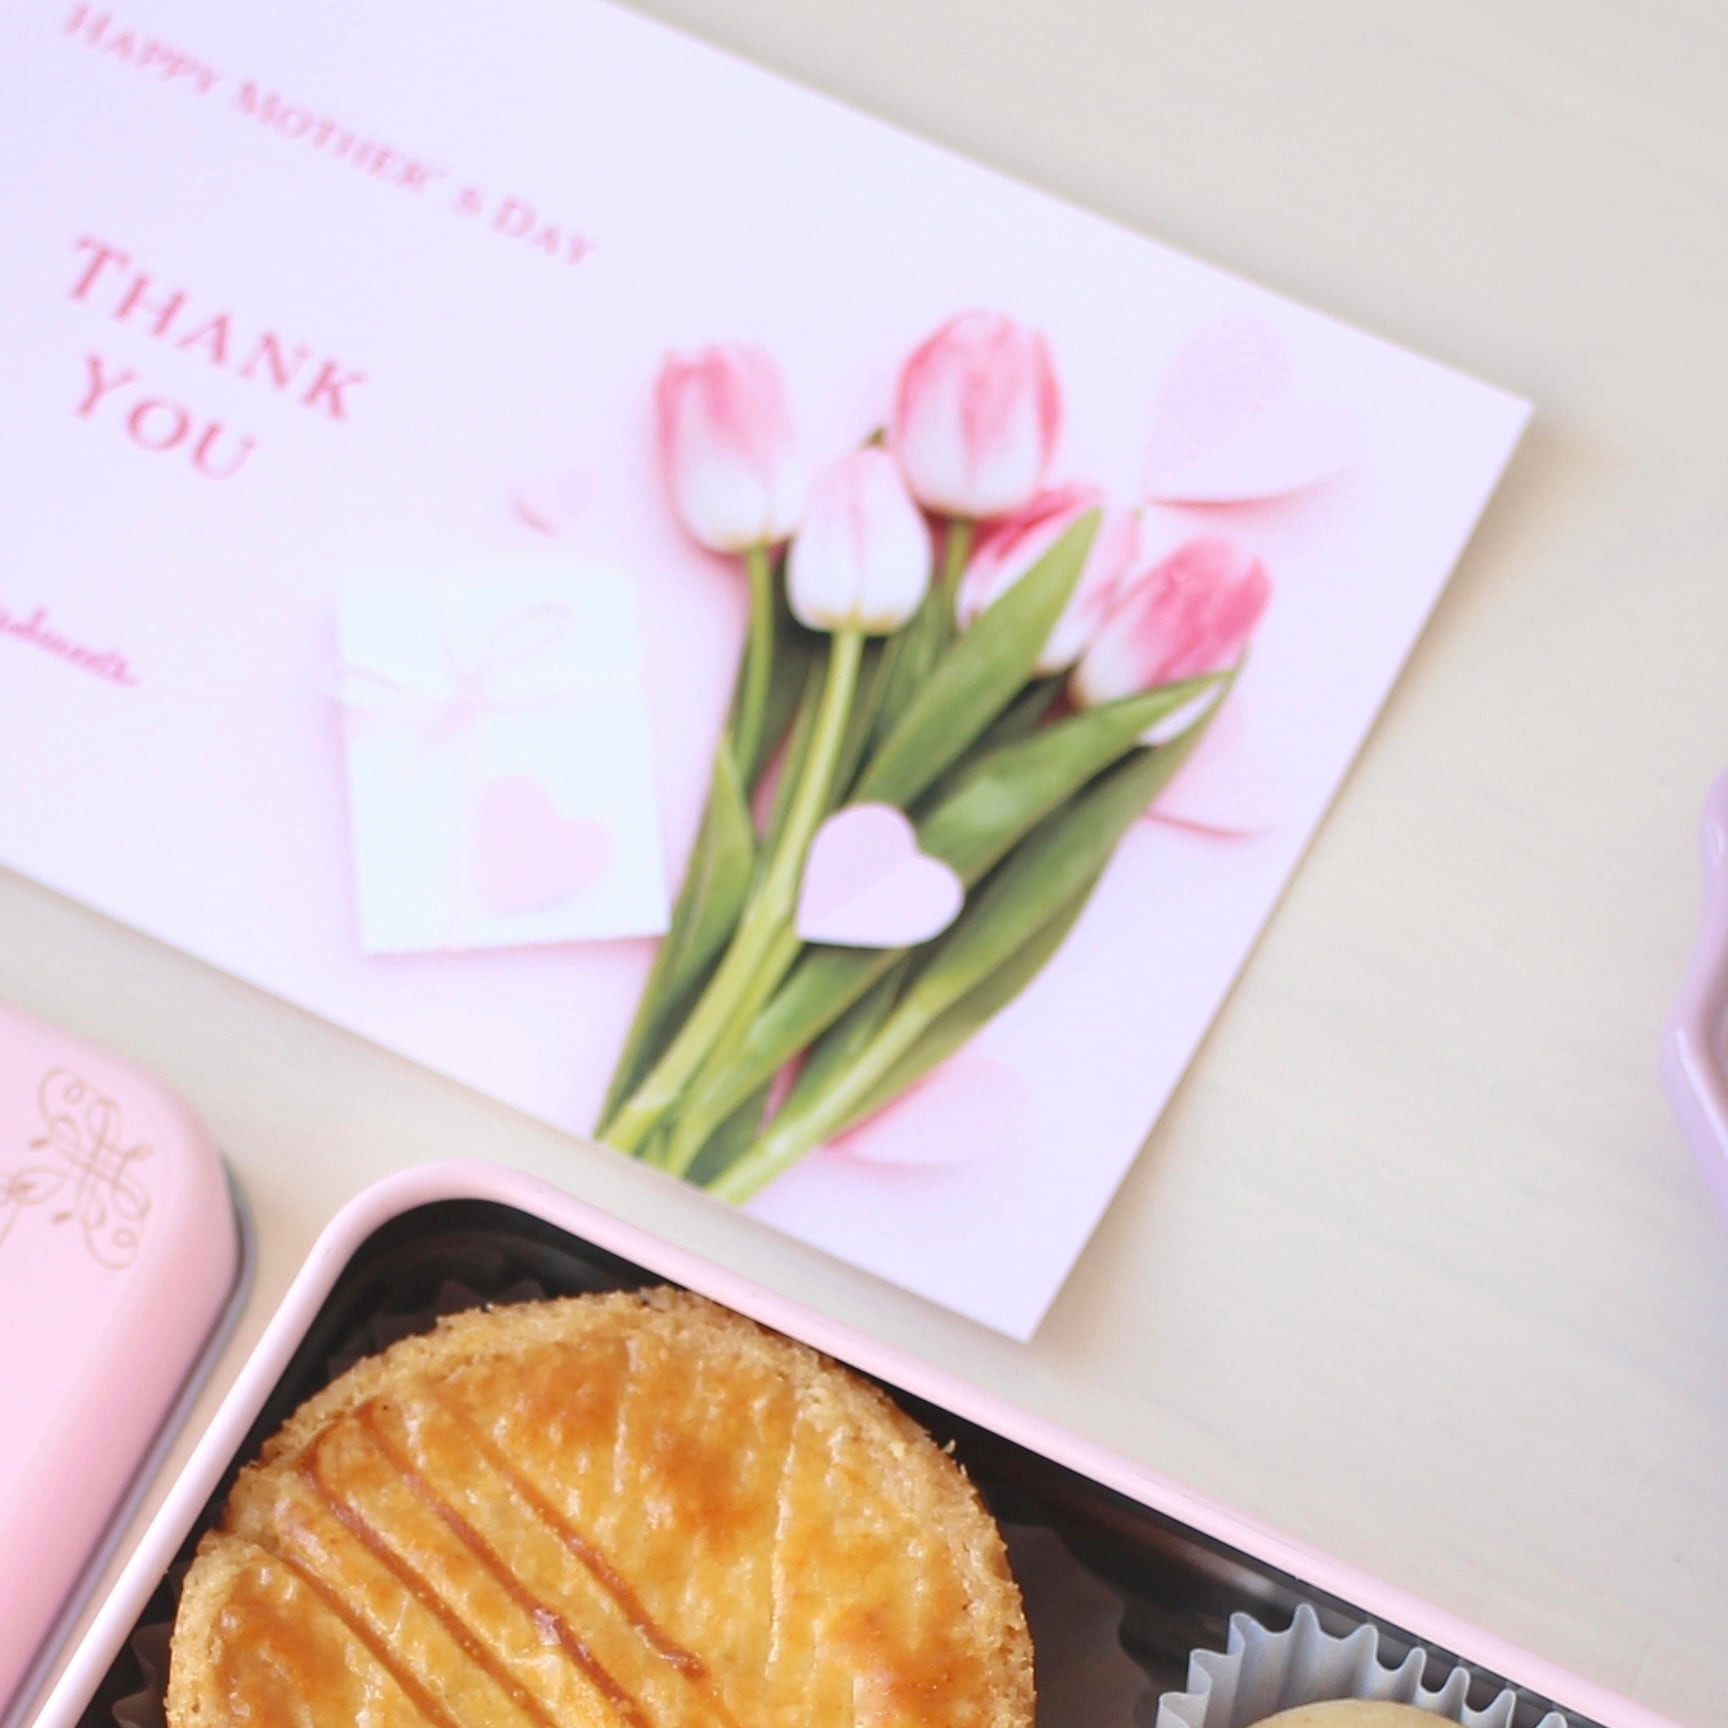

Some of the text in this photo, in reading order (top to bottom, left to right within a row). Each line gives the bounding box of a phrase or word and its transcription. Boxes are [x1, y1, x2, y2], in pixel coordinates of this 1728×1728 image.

[62, 3, 223, 95] HAPPY
[490, 194, 599, 266] DAY
[71, 236, 367, 421] THANK
[78, 352, 259, 481] YOU
